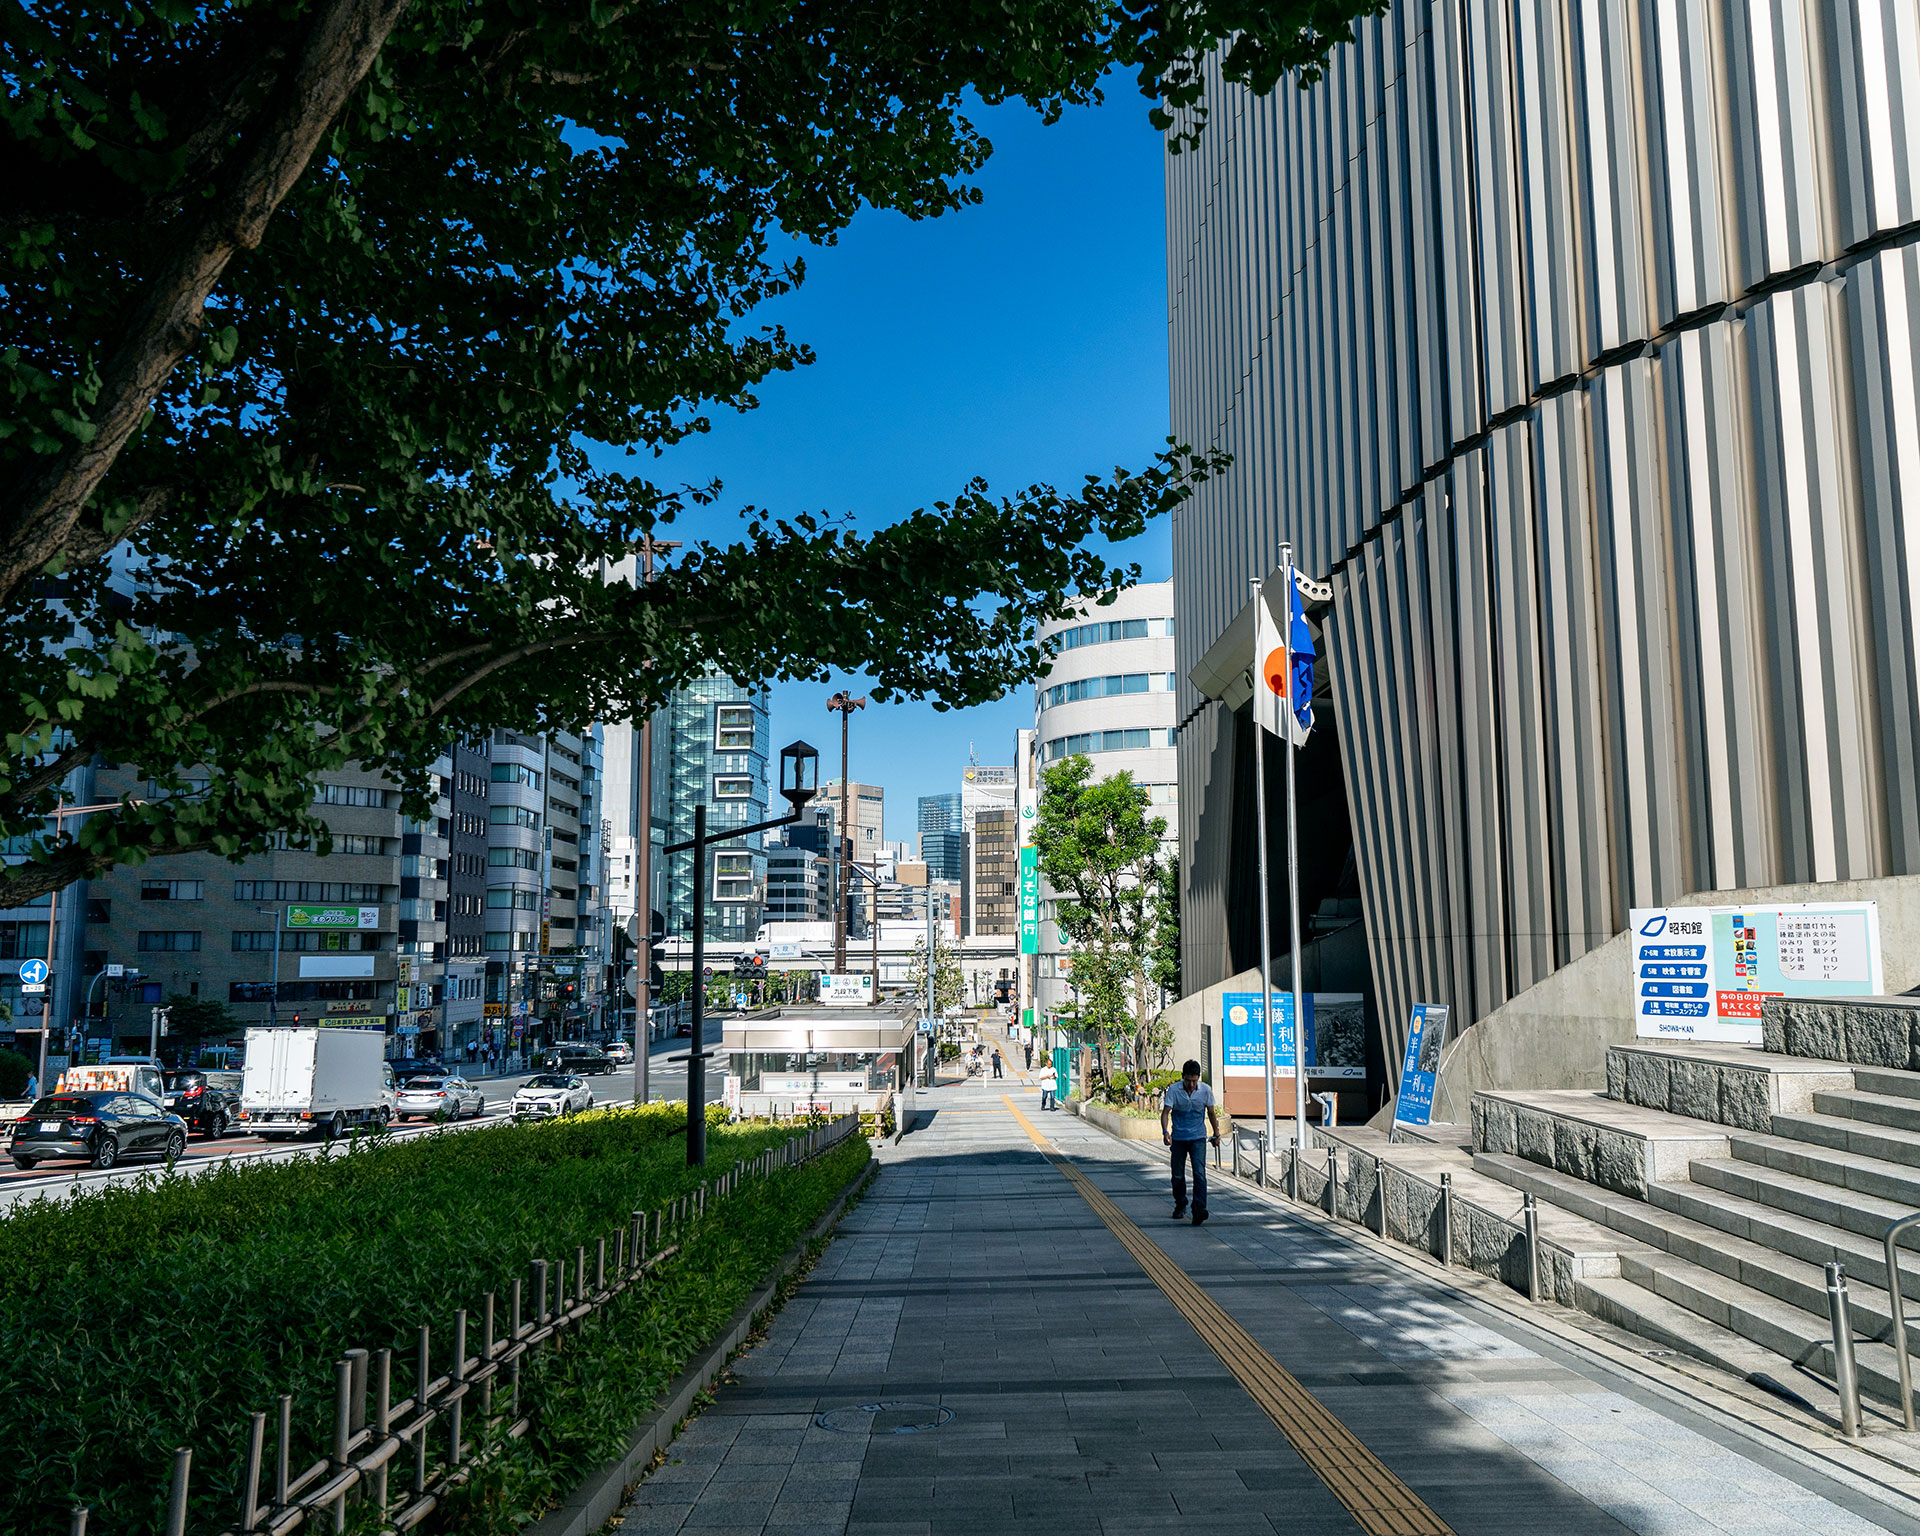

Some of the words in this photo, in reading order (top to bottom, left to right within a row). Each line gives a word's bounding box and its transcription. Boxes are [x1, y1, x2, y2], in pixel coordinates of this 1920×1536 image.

[1023, 866, 1036, 935] りそな銀行
[1669, 922, 1702, 935] 昭和館
[1721, 1002, 1760, 1011] 見えてくる
[1659, 1024, 1694, 1033] SHOWA-KAN
